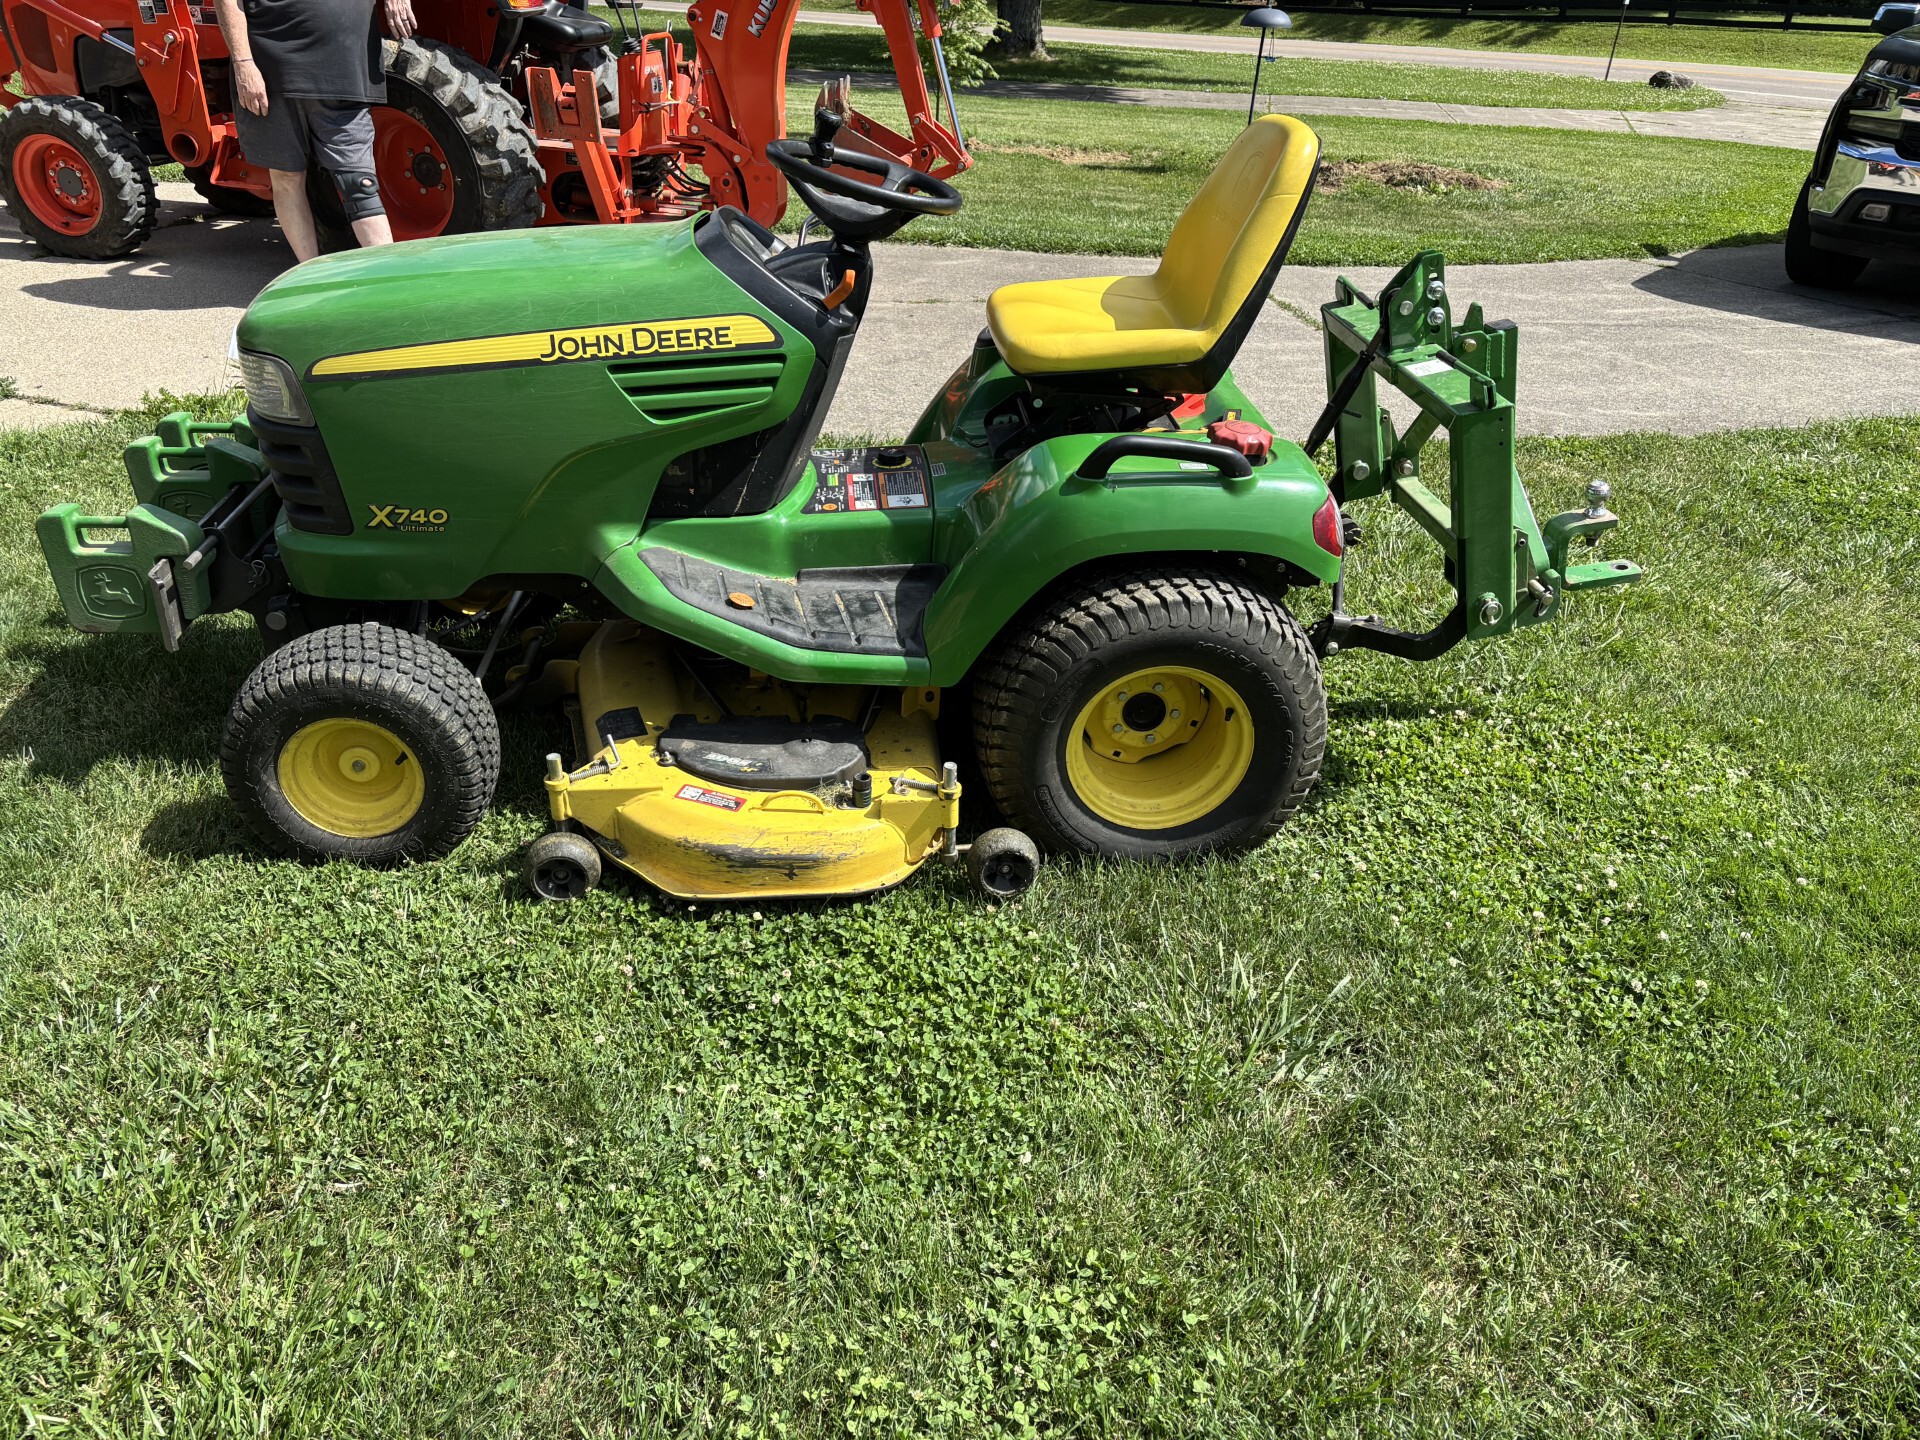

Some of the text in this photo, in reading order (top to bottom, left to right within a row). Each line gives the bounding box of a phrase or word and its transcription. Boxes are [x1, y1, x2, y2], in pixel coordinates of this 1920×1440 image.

[540, 326, 733, 359] JOHN DEERE
[367, 505, 448, 528] X740
